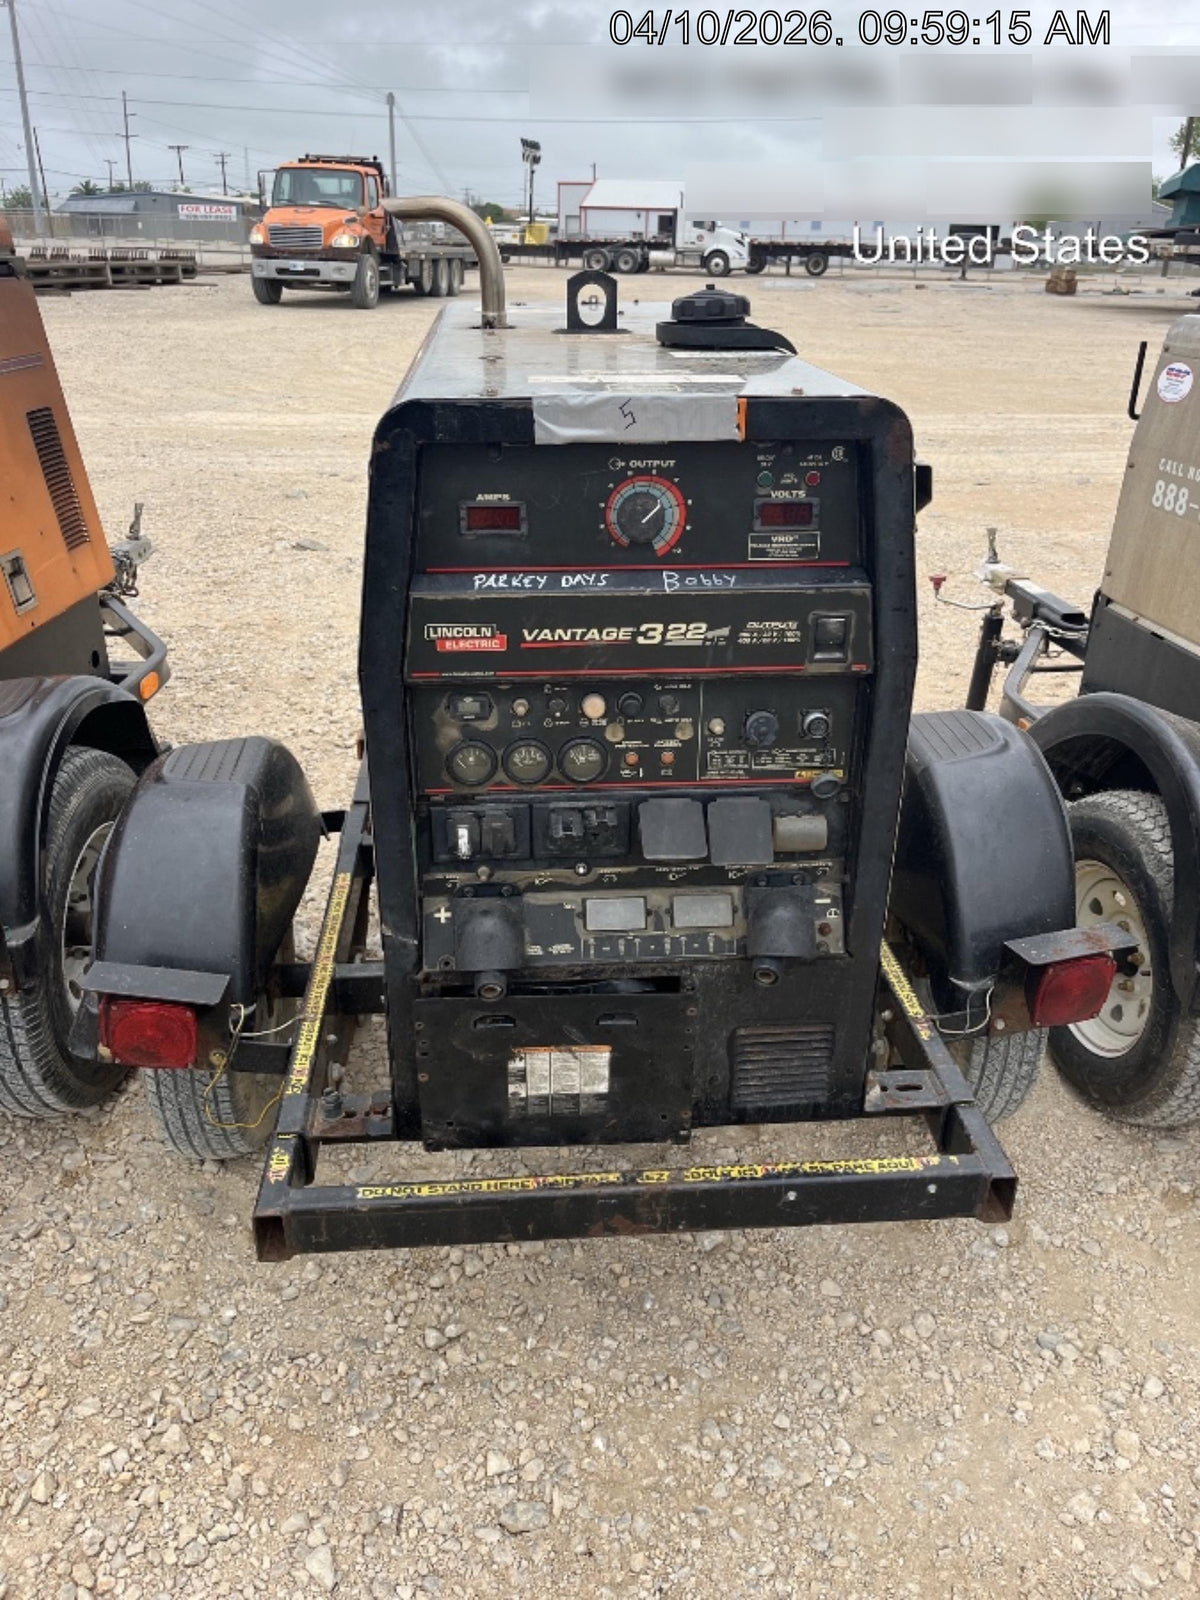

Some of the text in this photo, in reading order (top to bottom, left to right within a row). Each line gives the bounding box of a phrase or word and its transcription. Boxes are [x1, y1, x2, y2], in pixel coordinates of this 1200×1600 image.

[181, 205, 232, 214] FOR LEASE
[629, 460, 676, 468] OUTPUT
[1158, 457, 1184, 478] CALL
[770, 490, 806, 499] VOLTS
[1151, 480, 1200, 519] 888-
[429, 626, 492, 638] LINCOLN
[521, 622, 708, 645] VANTAGE 322
[445, 639, 500, 649] ELECTRIC
[427, 1182, 484, 1195] STAND
